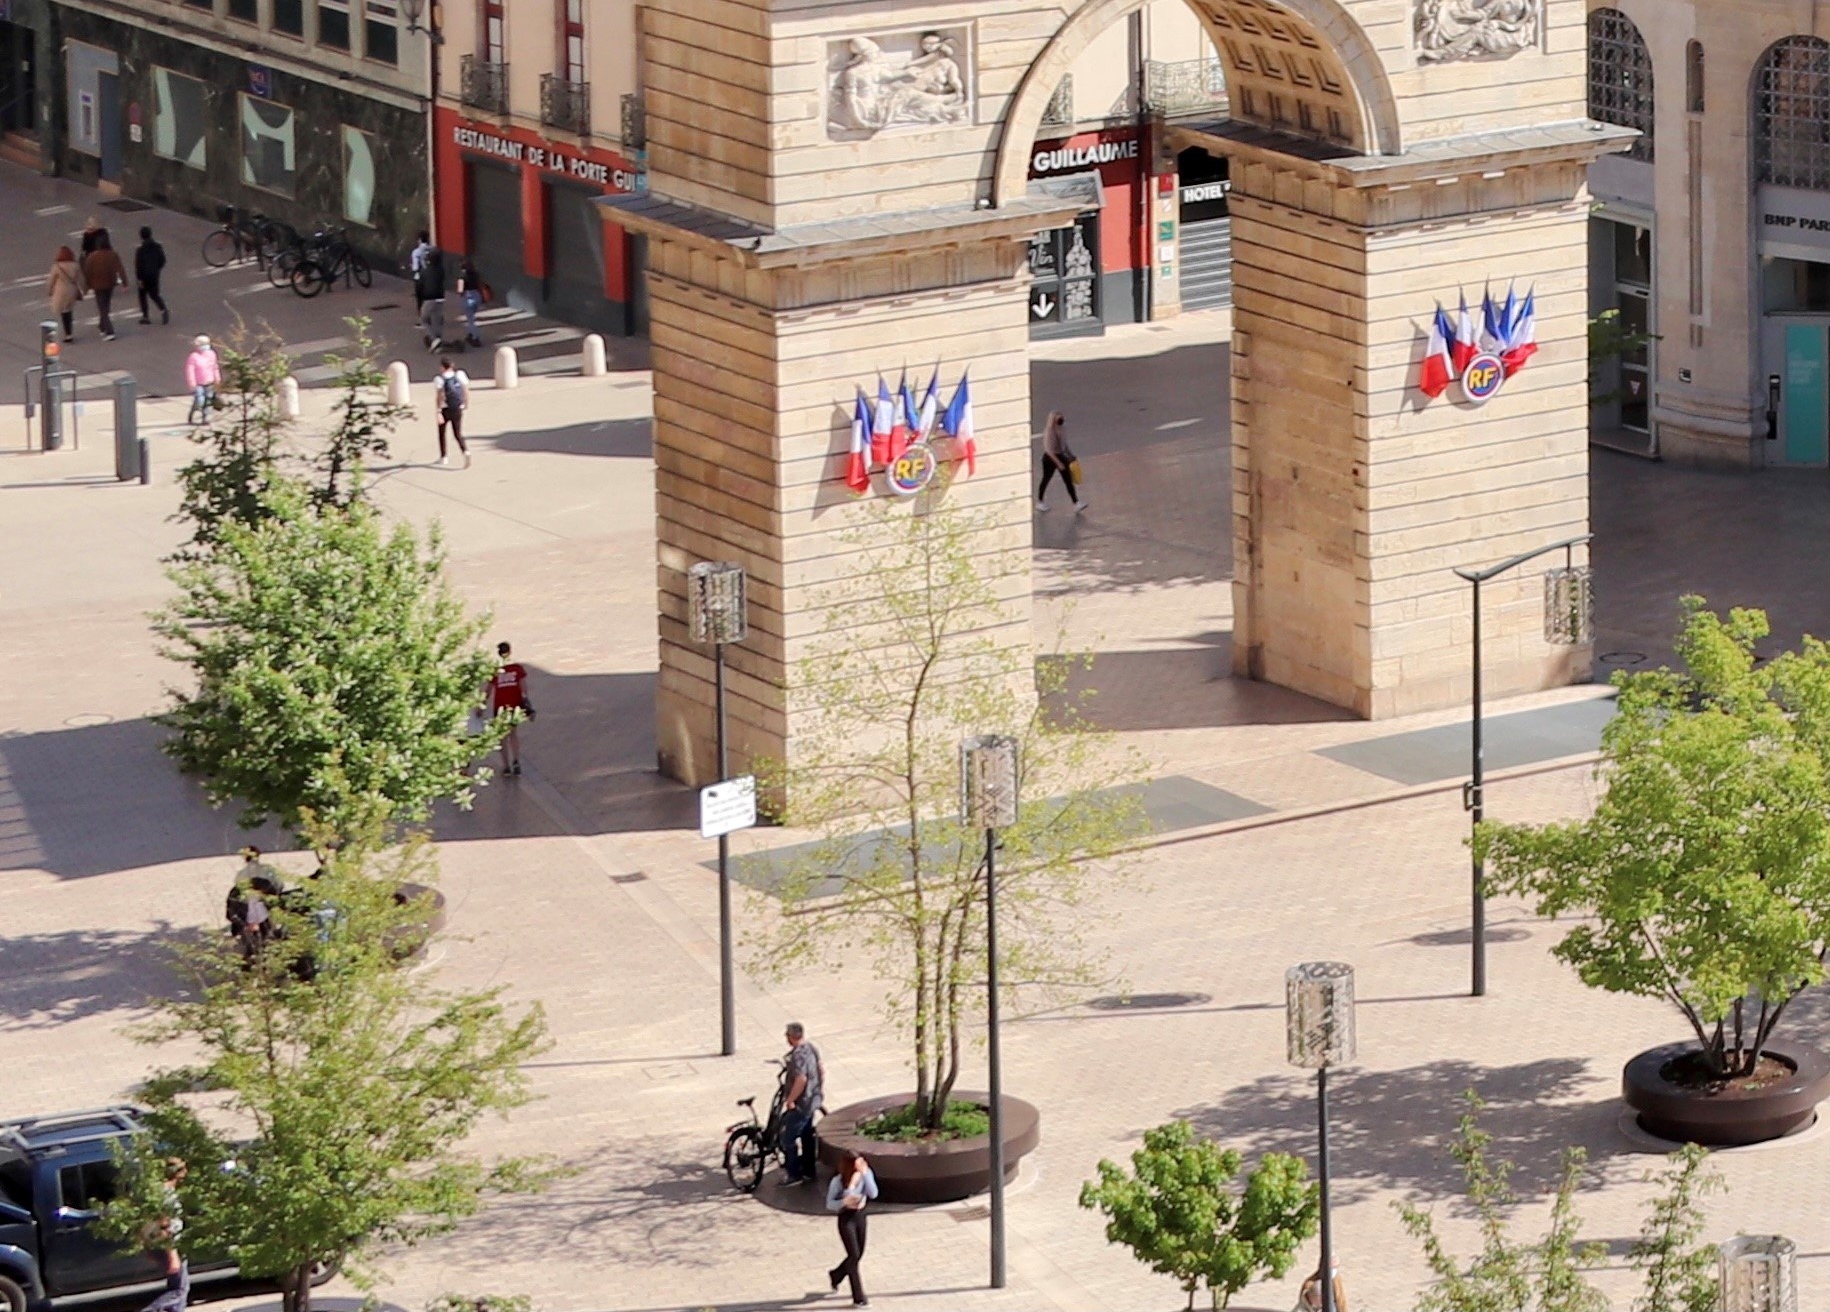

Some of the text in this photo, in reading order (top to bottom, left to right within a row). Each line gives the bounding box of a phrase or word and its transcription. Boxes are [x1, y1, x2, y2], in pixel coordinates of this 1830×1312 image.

[454, 127, 635, 191] RESTAURANT DE LA PORTE GUI
[1034, 140, 1138, 171] GUILLAUME
[1183, 185, 1223, 203] HOTEL
[1764, 214, 1796, 227] BNP
[1469, 367, 1498, 389] RF
[895, 458, 926, 481] RF
